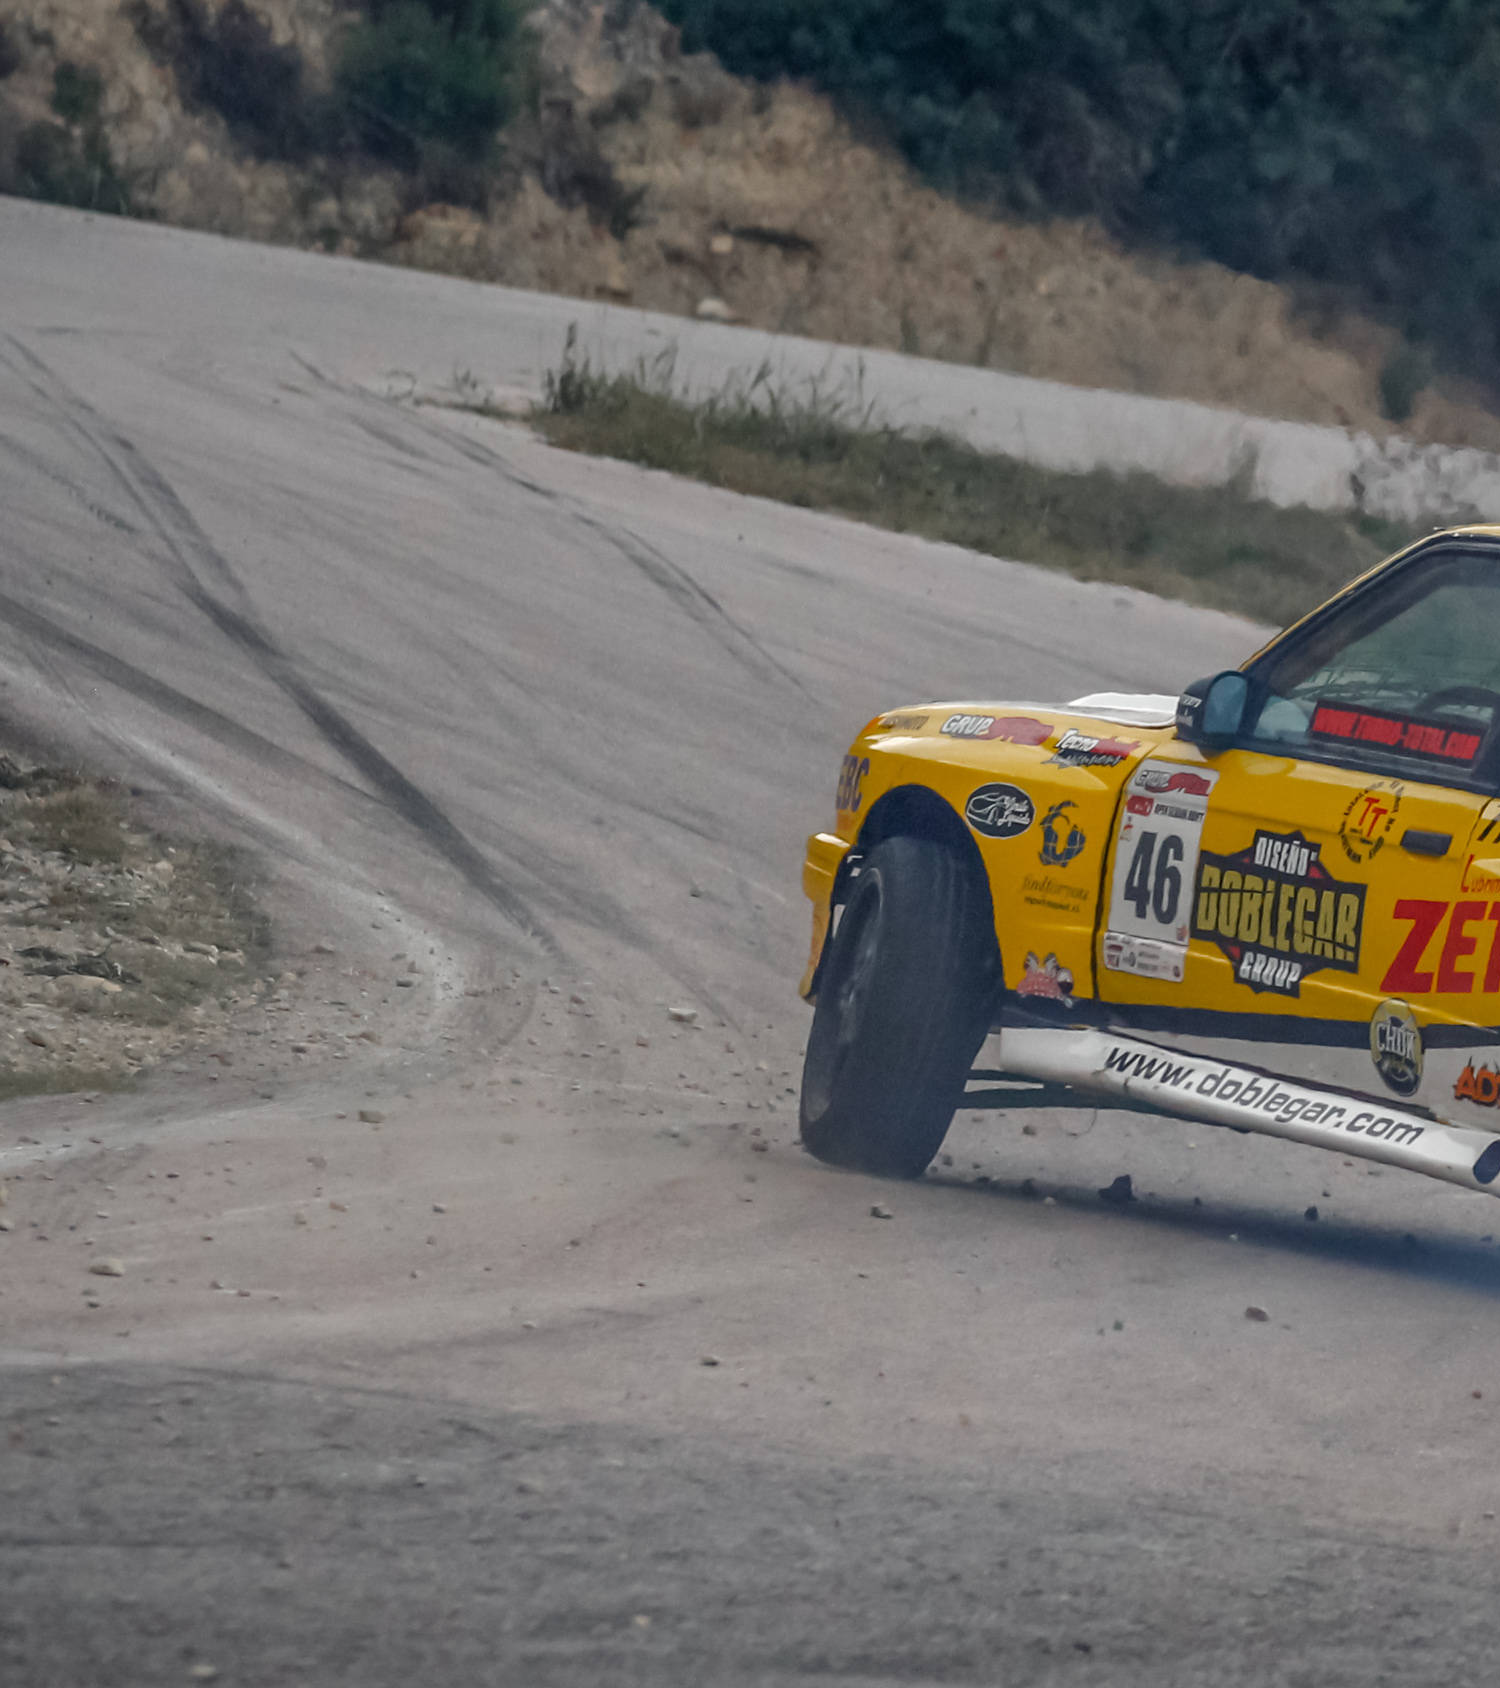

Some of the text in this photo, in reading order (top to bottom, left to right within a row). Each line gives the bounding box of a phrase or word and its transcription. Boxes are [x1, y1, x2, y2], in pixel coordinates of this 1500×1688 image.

[1124, 831, 1184, 925] 46
[1196, 864, 1360, 963] DOBLEGAR
[1239, 951, 1303, 990] GROUP
[1105, 1047, 1425, 1146] www.doblegar.com
